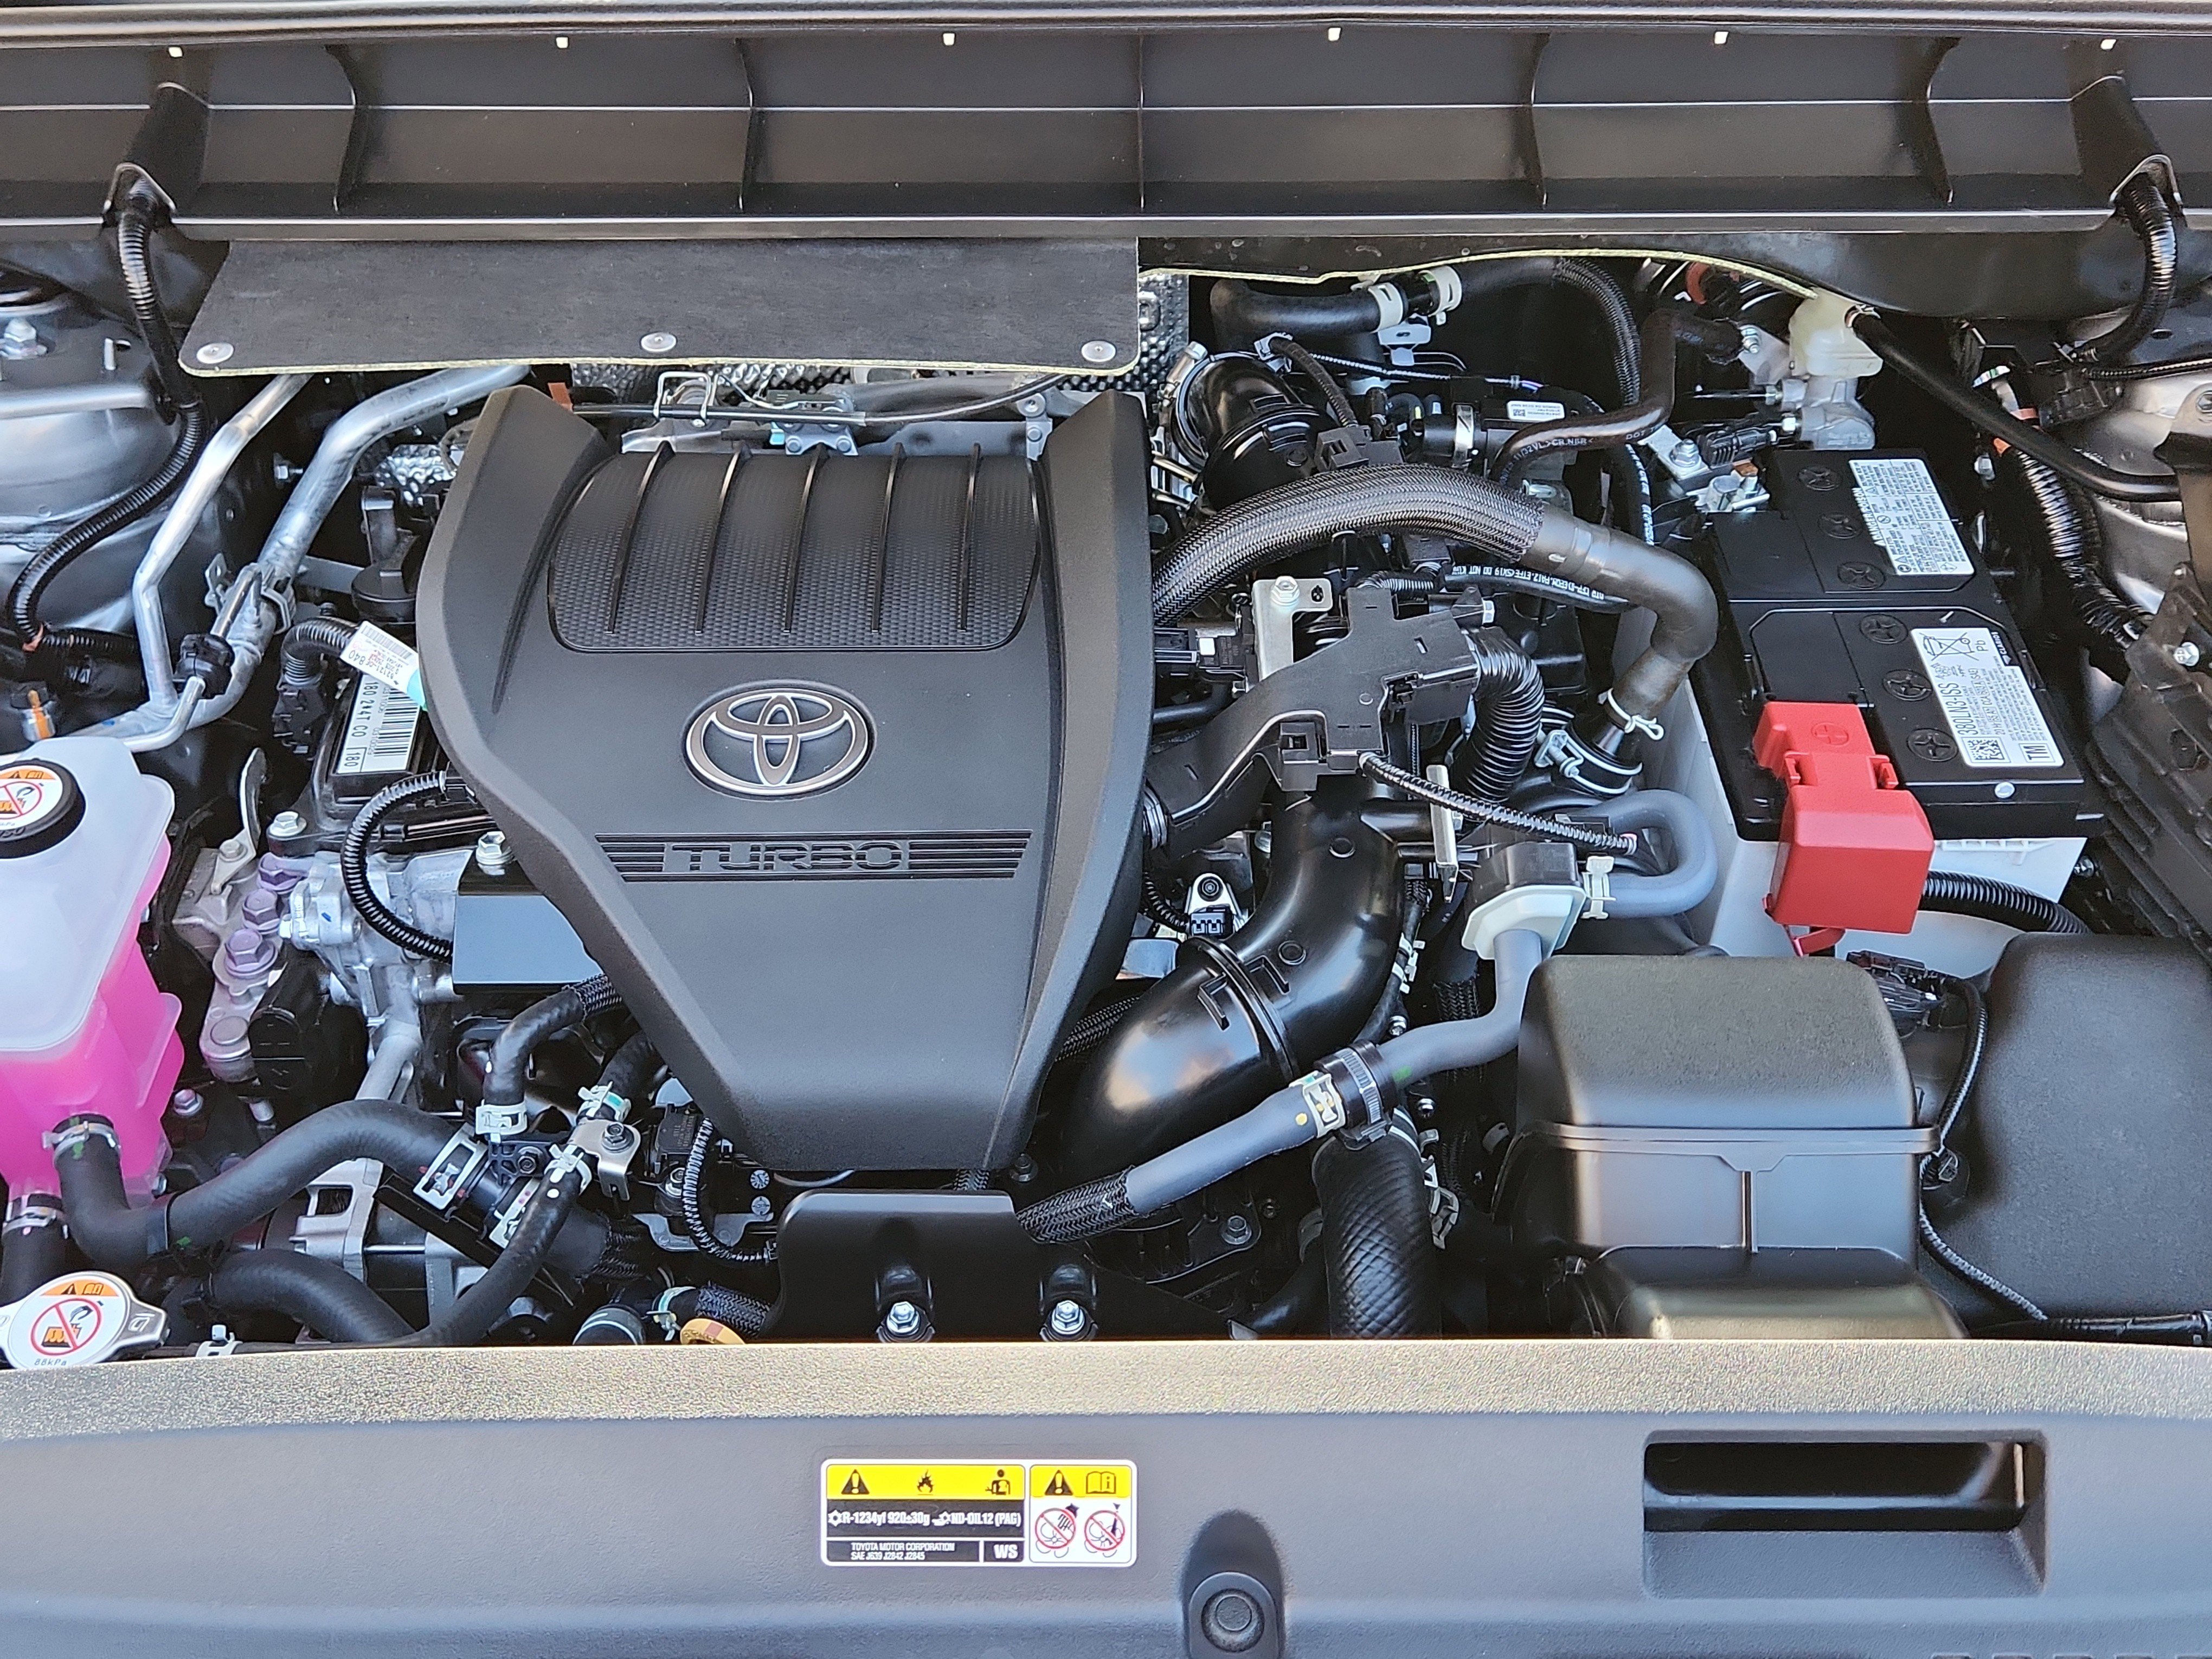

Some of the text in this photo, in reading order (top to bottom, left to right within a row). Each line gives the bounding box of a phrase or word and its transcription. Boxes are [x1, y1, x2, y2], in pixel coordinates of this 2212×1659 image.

[1976, 640, 1989, 652] Pb
[363, 683, 379, 695] 180
[344, 753, 360, 767] 180
[2023, 746, 2052, 760] TM
[671, 841, 904, 871] TURBO
[994, 1512, 1021, 1527] (PAG)
[851, 1542, 955, 1551] TOYOTA MOTOR CORPORATION
[994, 1544, 1018, 1559] WS
[851, 1552, 865, 1560] SAE
